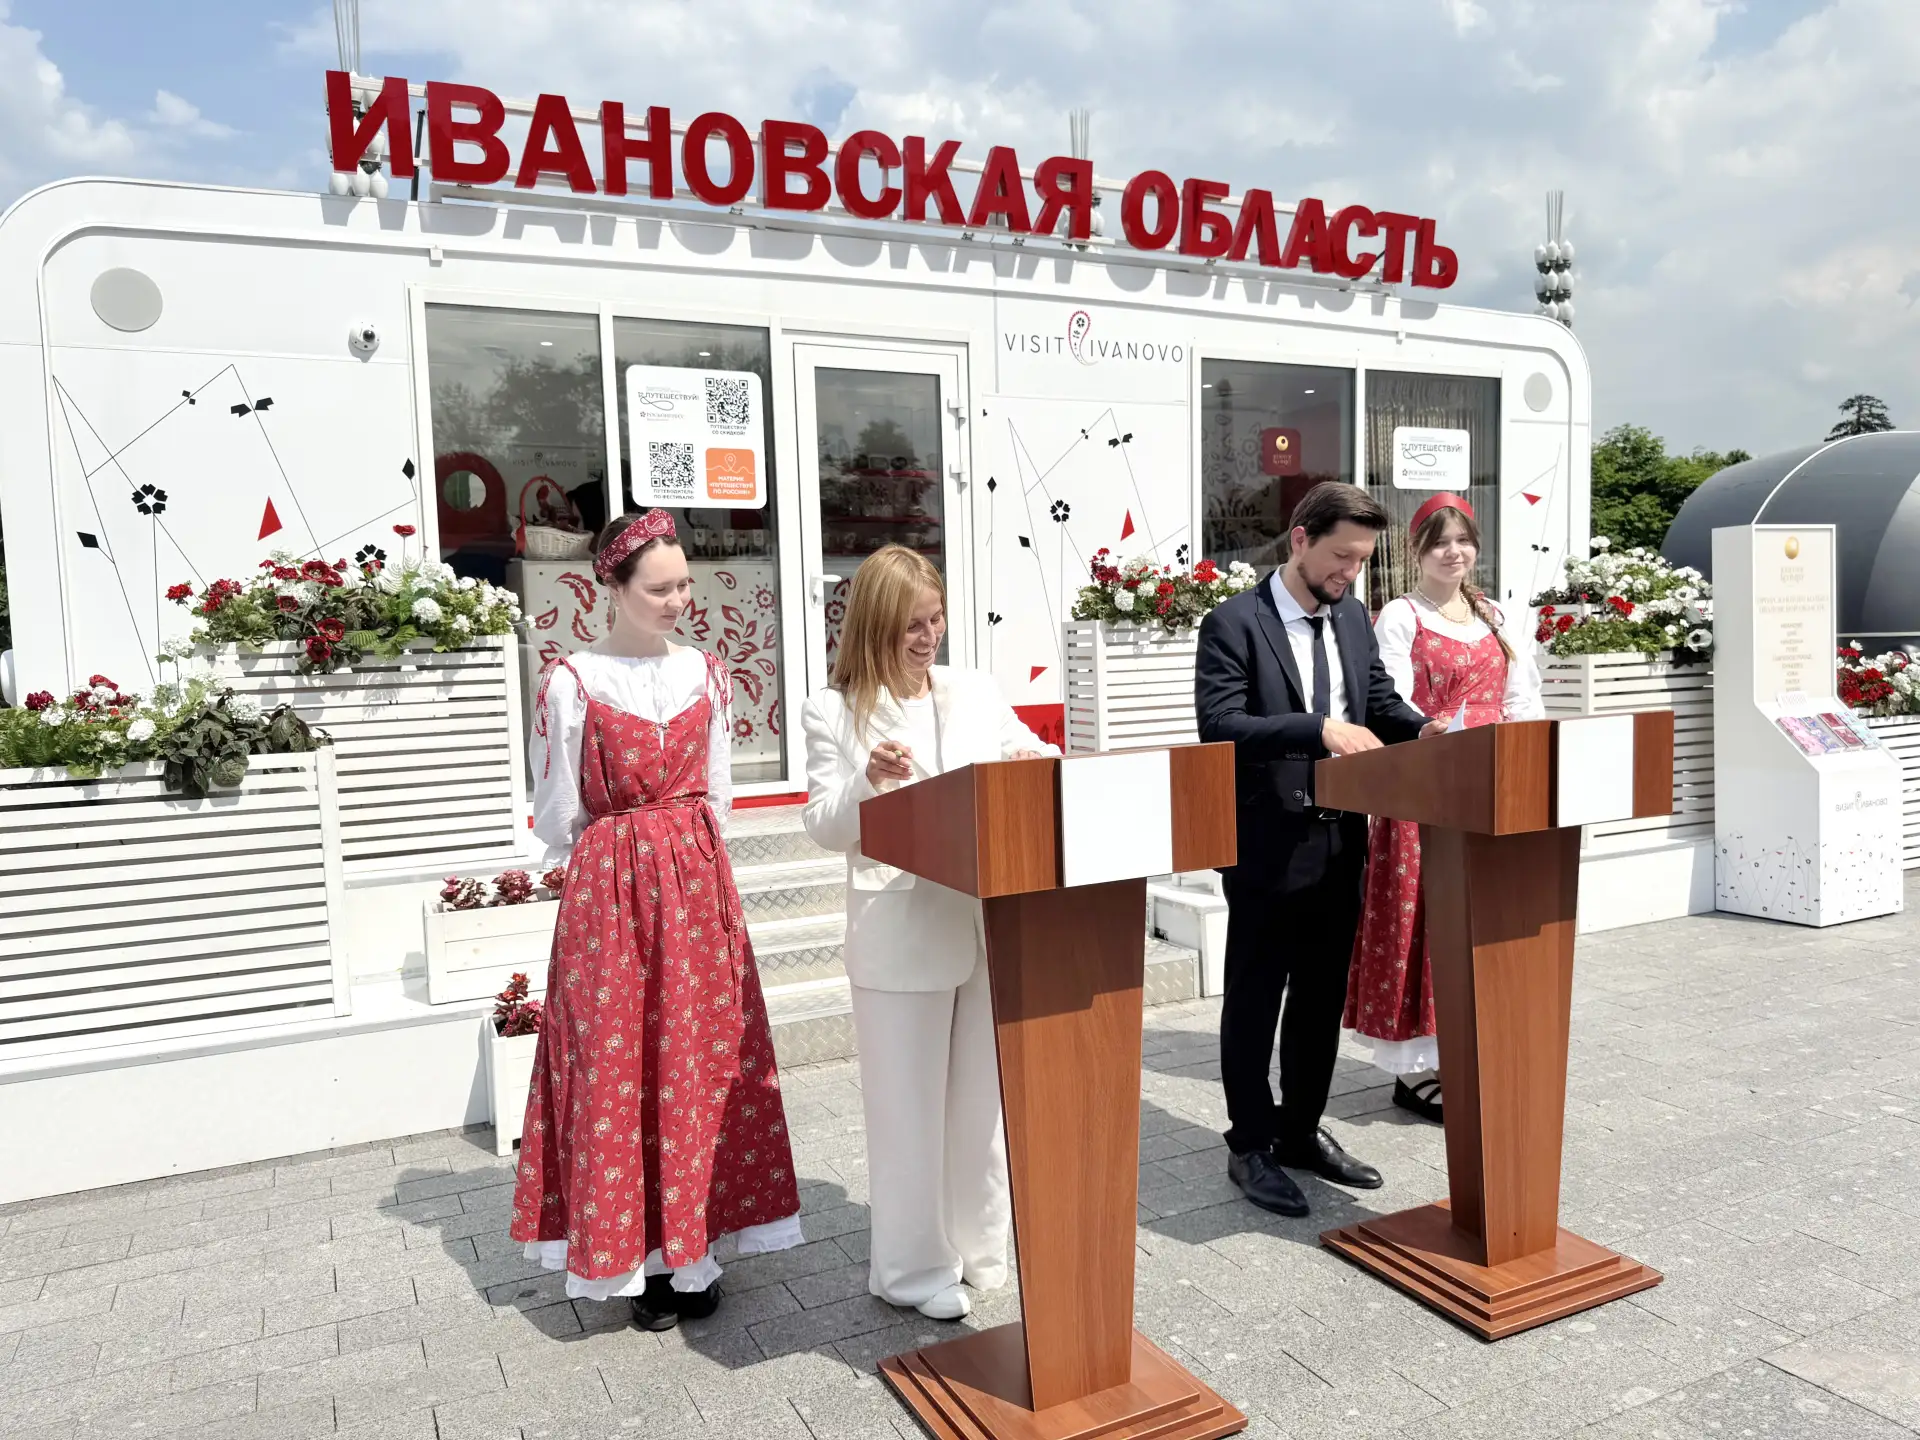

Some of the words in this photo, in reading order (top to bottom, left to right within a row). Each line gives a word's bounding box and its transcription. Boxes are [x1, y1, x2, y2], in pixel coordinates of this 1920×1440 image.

[325, 70, 1093, 240] ИВАНОВСКАЯ
[1120, 170, 1459, 290] ОБЛАСТЬ
[1004, 333, 1065, 355] VISIT
[1090, 339, 1183, 363] IVANOVO
[645, 391, 700, 401] ПУТЕШЕСТВУЙ!
[1408, 443, 1463, 454] ПУТЕШЕСТВУЙ!
